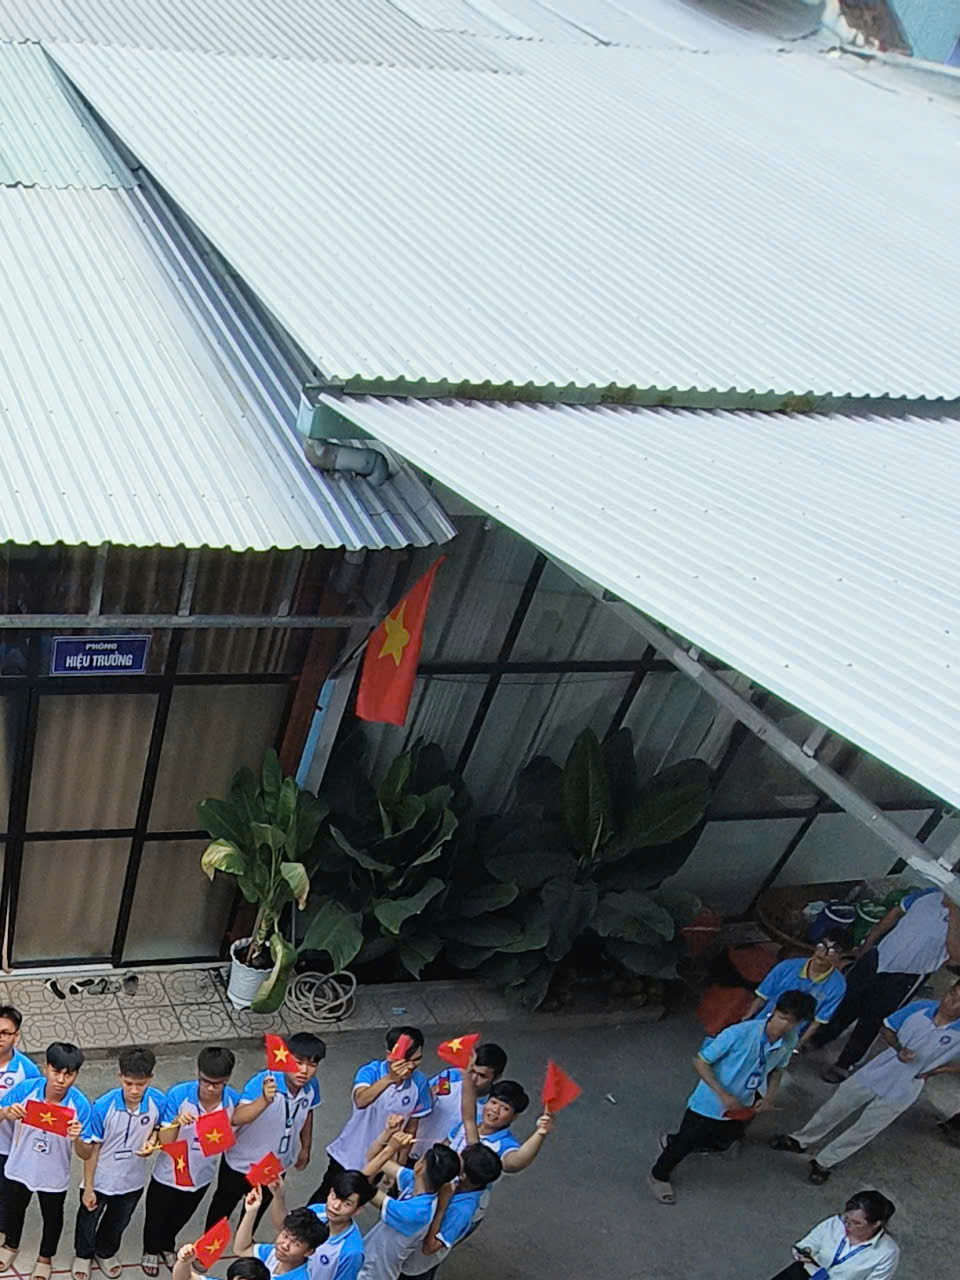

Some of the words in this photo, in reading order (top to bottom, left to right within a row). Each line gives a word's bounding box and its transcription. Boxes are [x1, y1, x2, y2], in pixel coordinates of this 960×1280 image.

[85, 642, 118, 651] PHÒNG
[65, 653, 90, 669] HIỆU
[92, 651, 133, 667] TRƯỞNG
